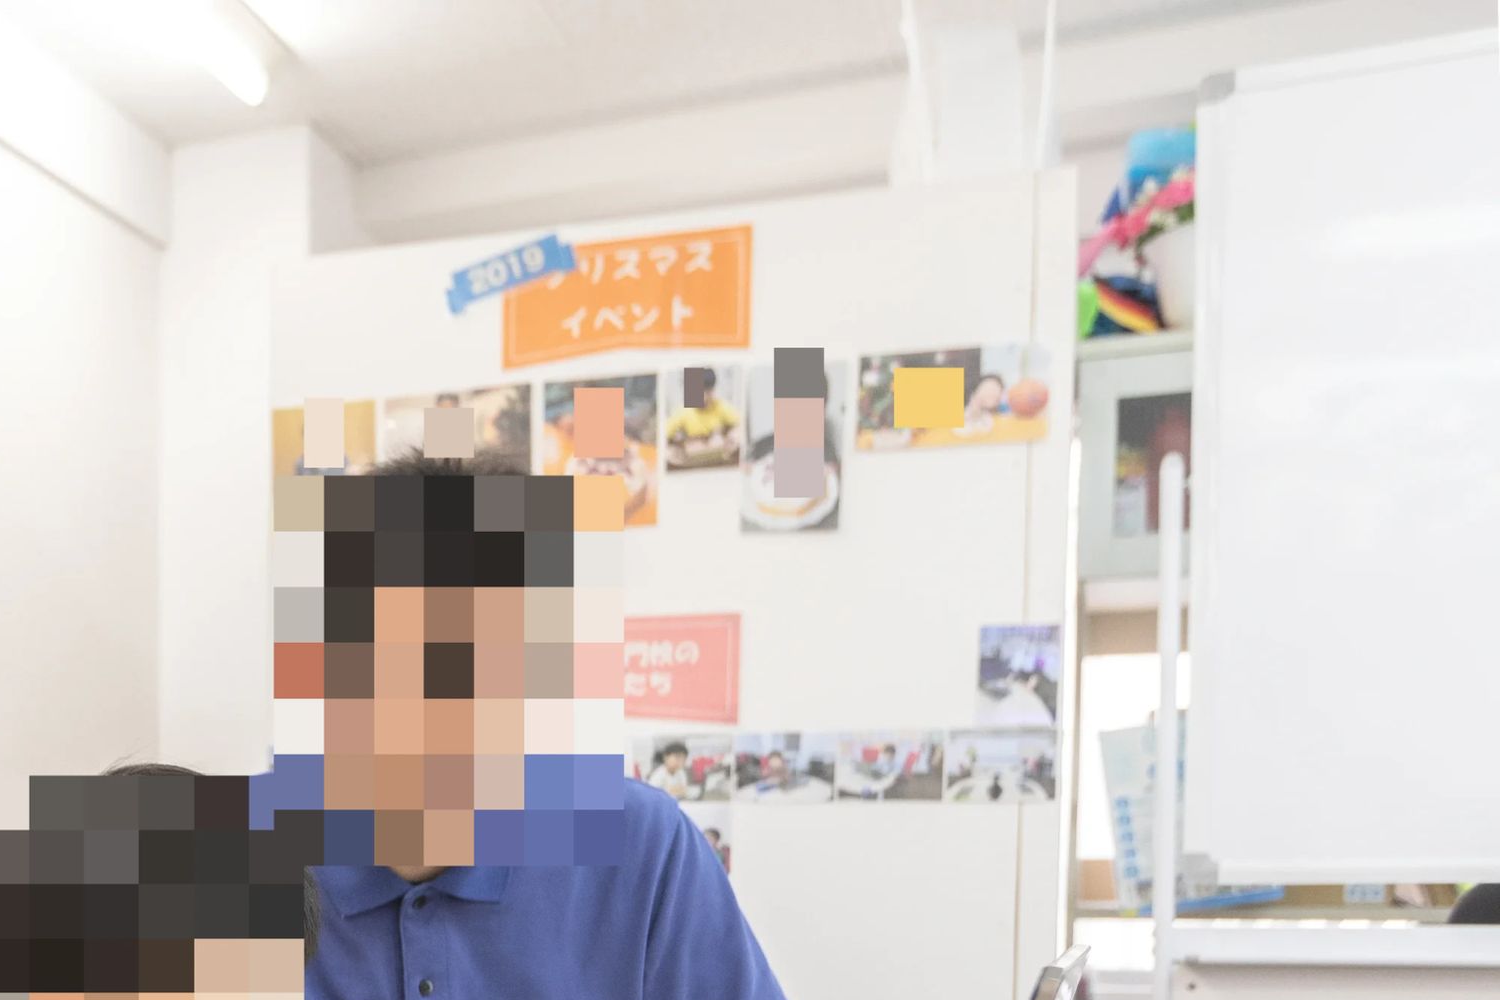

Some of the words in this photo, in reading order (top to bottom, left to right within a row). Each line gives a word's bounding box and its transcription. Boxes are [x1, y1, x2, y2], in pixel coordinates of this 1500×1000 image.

[468, 246, 545, 295] 2019
[547, 241, 713, 290] リスマス
[562, 294, 695, 339] イベント
